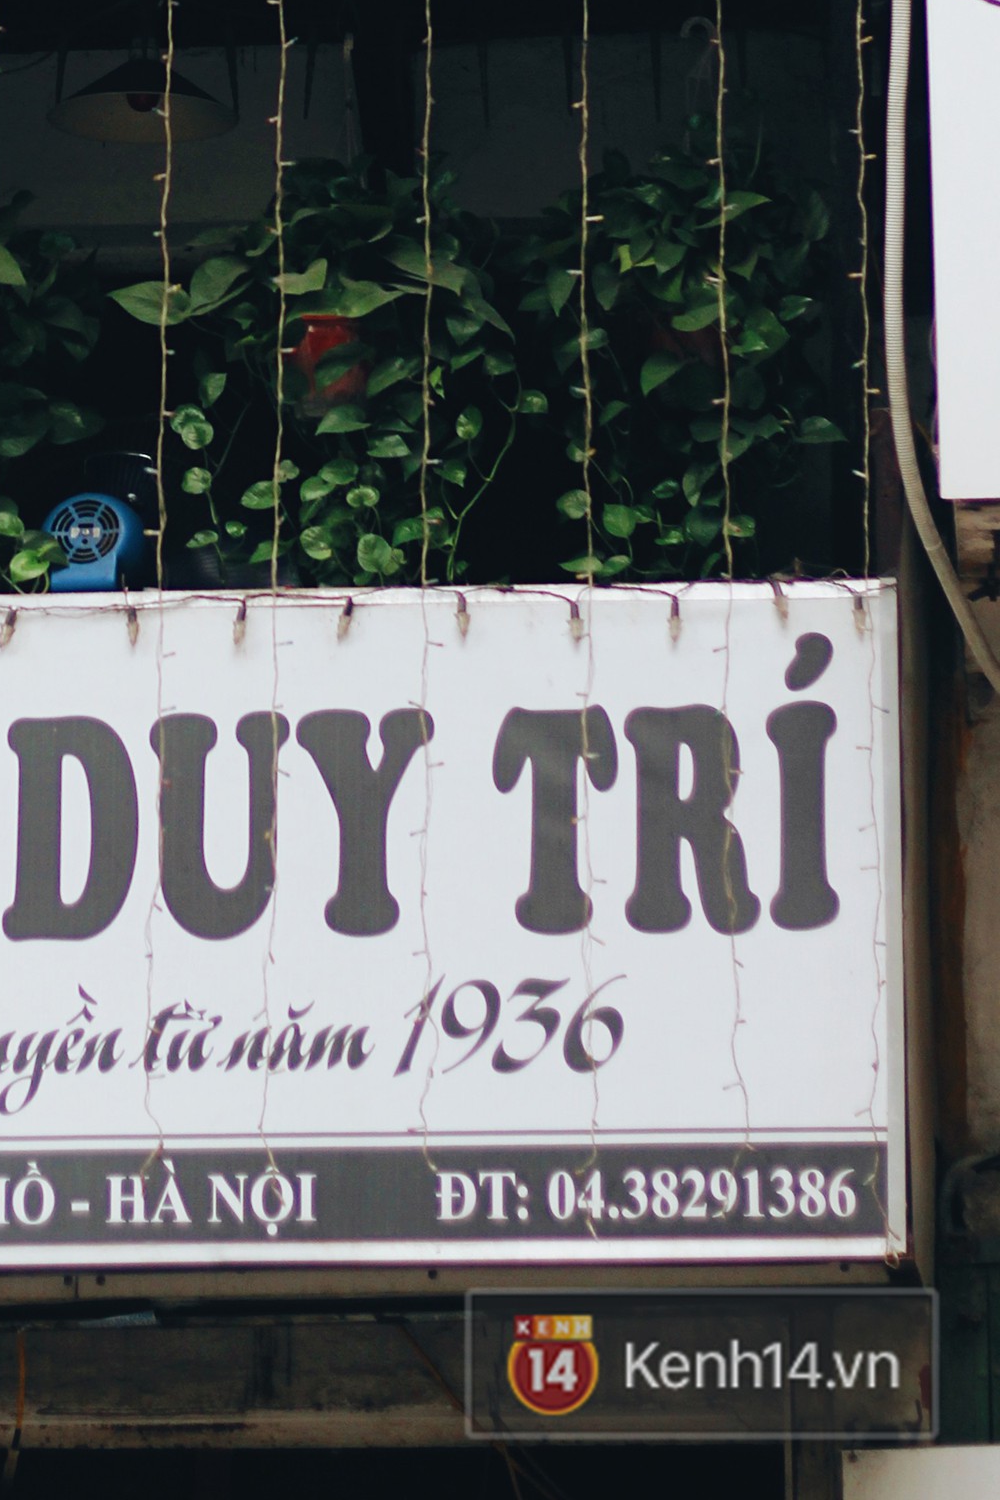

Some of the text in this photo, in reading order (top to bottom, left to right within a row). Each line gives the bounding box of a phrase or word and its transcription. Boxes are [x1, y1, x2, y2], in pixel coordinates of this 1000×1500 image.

[2, 706, 435, 942] DUY
[492, 632, 841, 936] TRÍ
[128, 998, 223, 1073] từ
[217, 1000, 375, 1072] năm
[393, 974, 628, 1077] 1936
[106, 1159, 192, 1225] HÀ
[207, 1164, 318, 1236] NỘI
[436, 1168, 858, 1221] ĐT: 04.38291386
